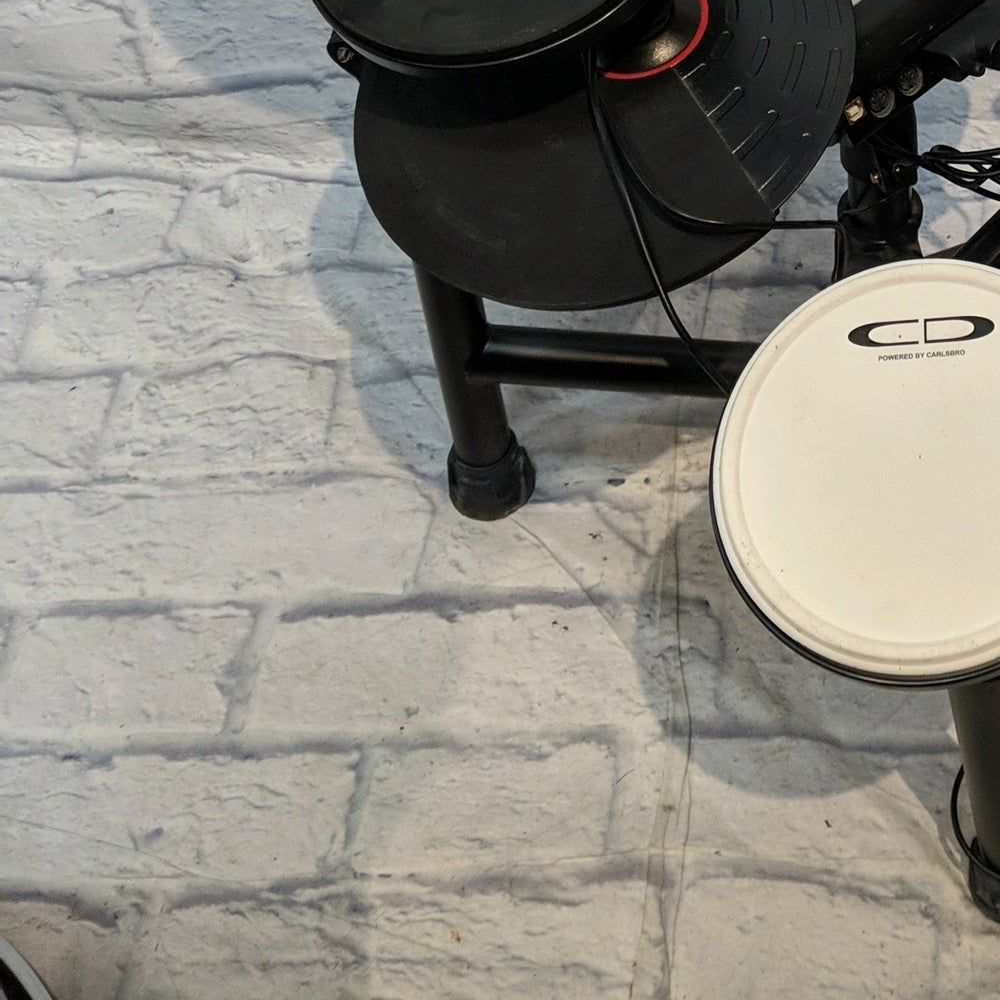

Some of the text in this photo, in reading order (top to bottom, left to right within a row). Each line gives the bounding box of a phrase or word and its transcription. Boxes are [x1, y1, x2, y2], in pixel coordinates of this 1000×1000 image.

[848, 315, 995, 347] CD
[878, 353, 913, 362] POWERED
[926, 349, 966, 358] CARLSBRO
